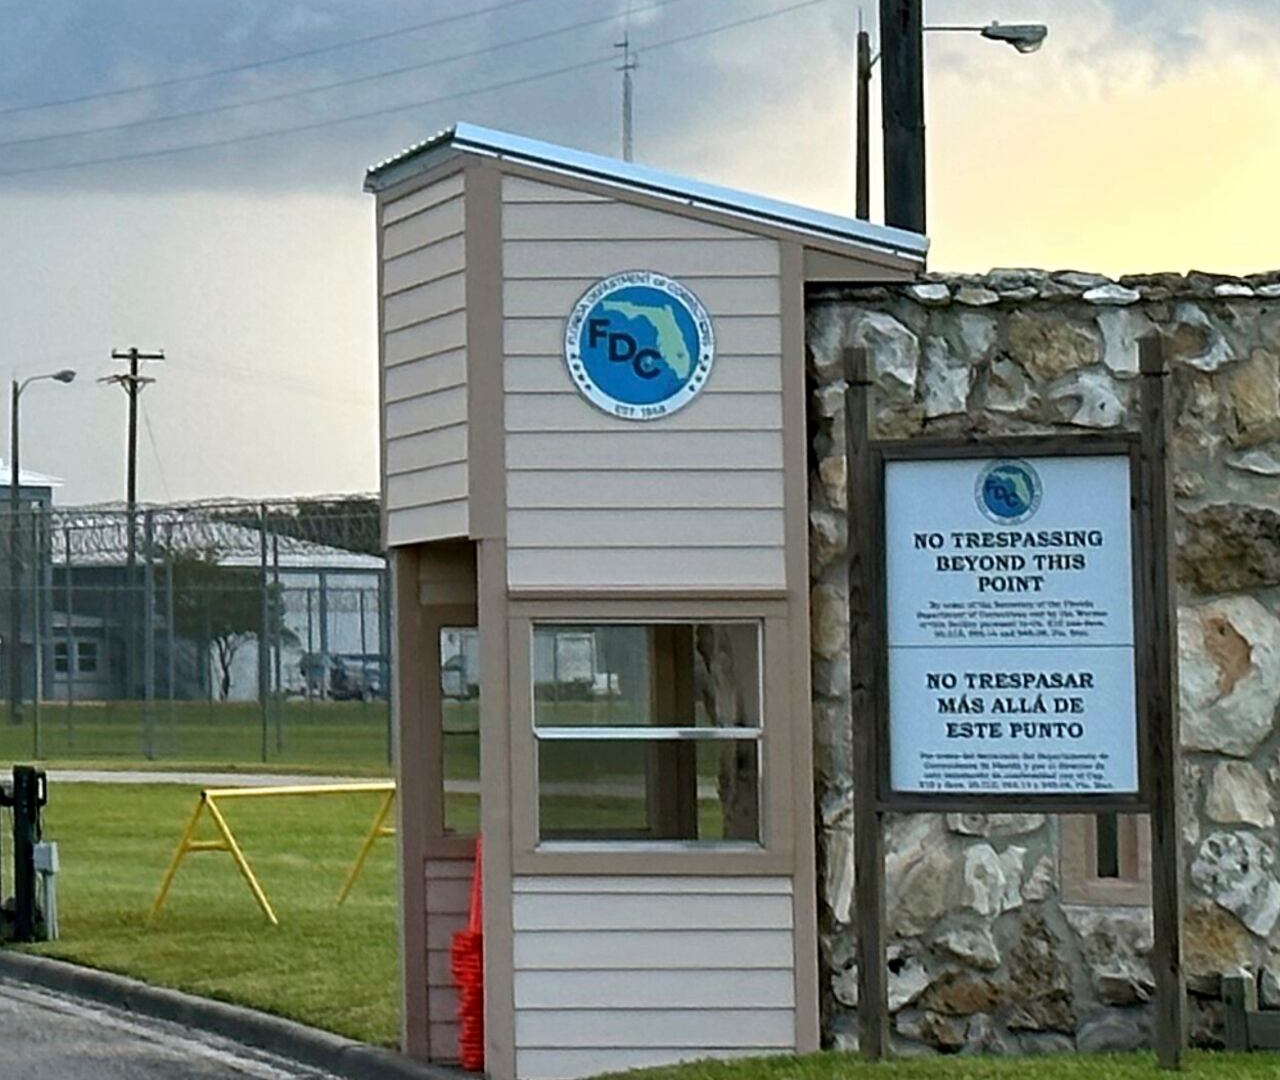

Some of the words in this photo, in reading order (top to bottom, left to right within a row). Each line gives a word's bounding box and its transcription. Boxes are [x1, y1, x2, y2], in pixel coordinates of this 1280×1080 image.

[588, 318, 662, 380] FDC
[914, 532, 944, 550] NO
[950, 530, 1103, 549] TRESPASSING
[936, 554, 1026, 572] BEYOND
[1032, 553, 1086, 571] THIS
[978, 575, 1045, 593] POINT
[926, 673, 957, 690] NO
[964, 672, 1094, 690] TRESPASAR
[937, 694, 985, 714] MÁS
[991, 693, 1047, 714] ALLÁ
[1053, 697, 1084, 714] DE
[946, 722, 1003, 739] ESTE
[1009, 722, 1084, 739] PUNTO
